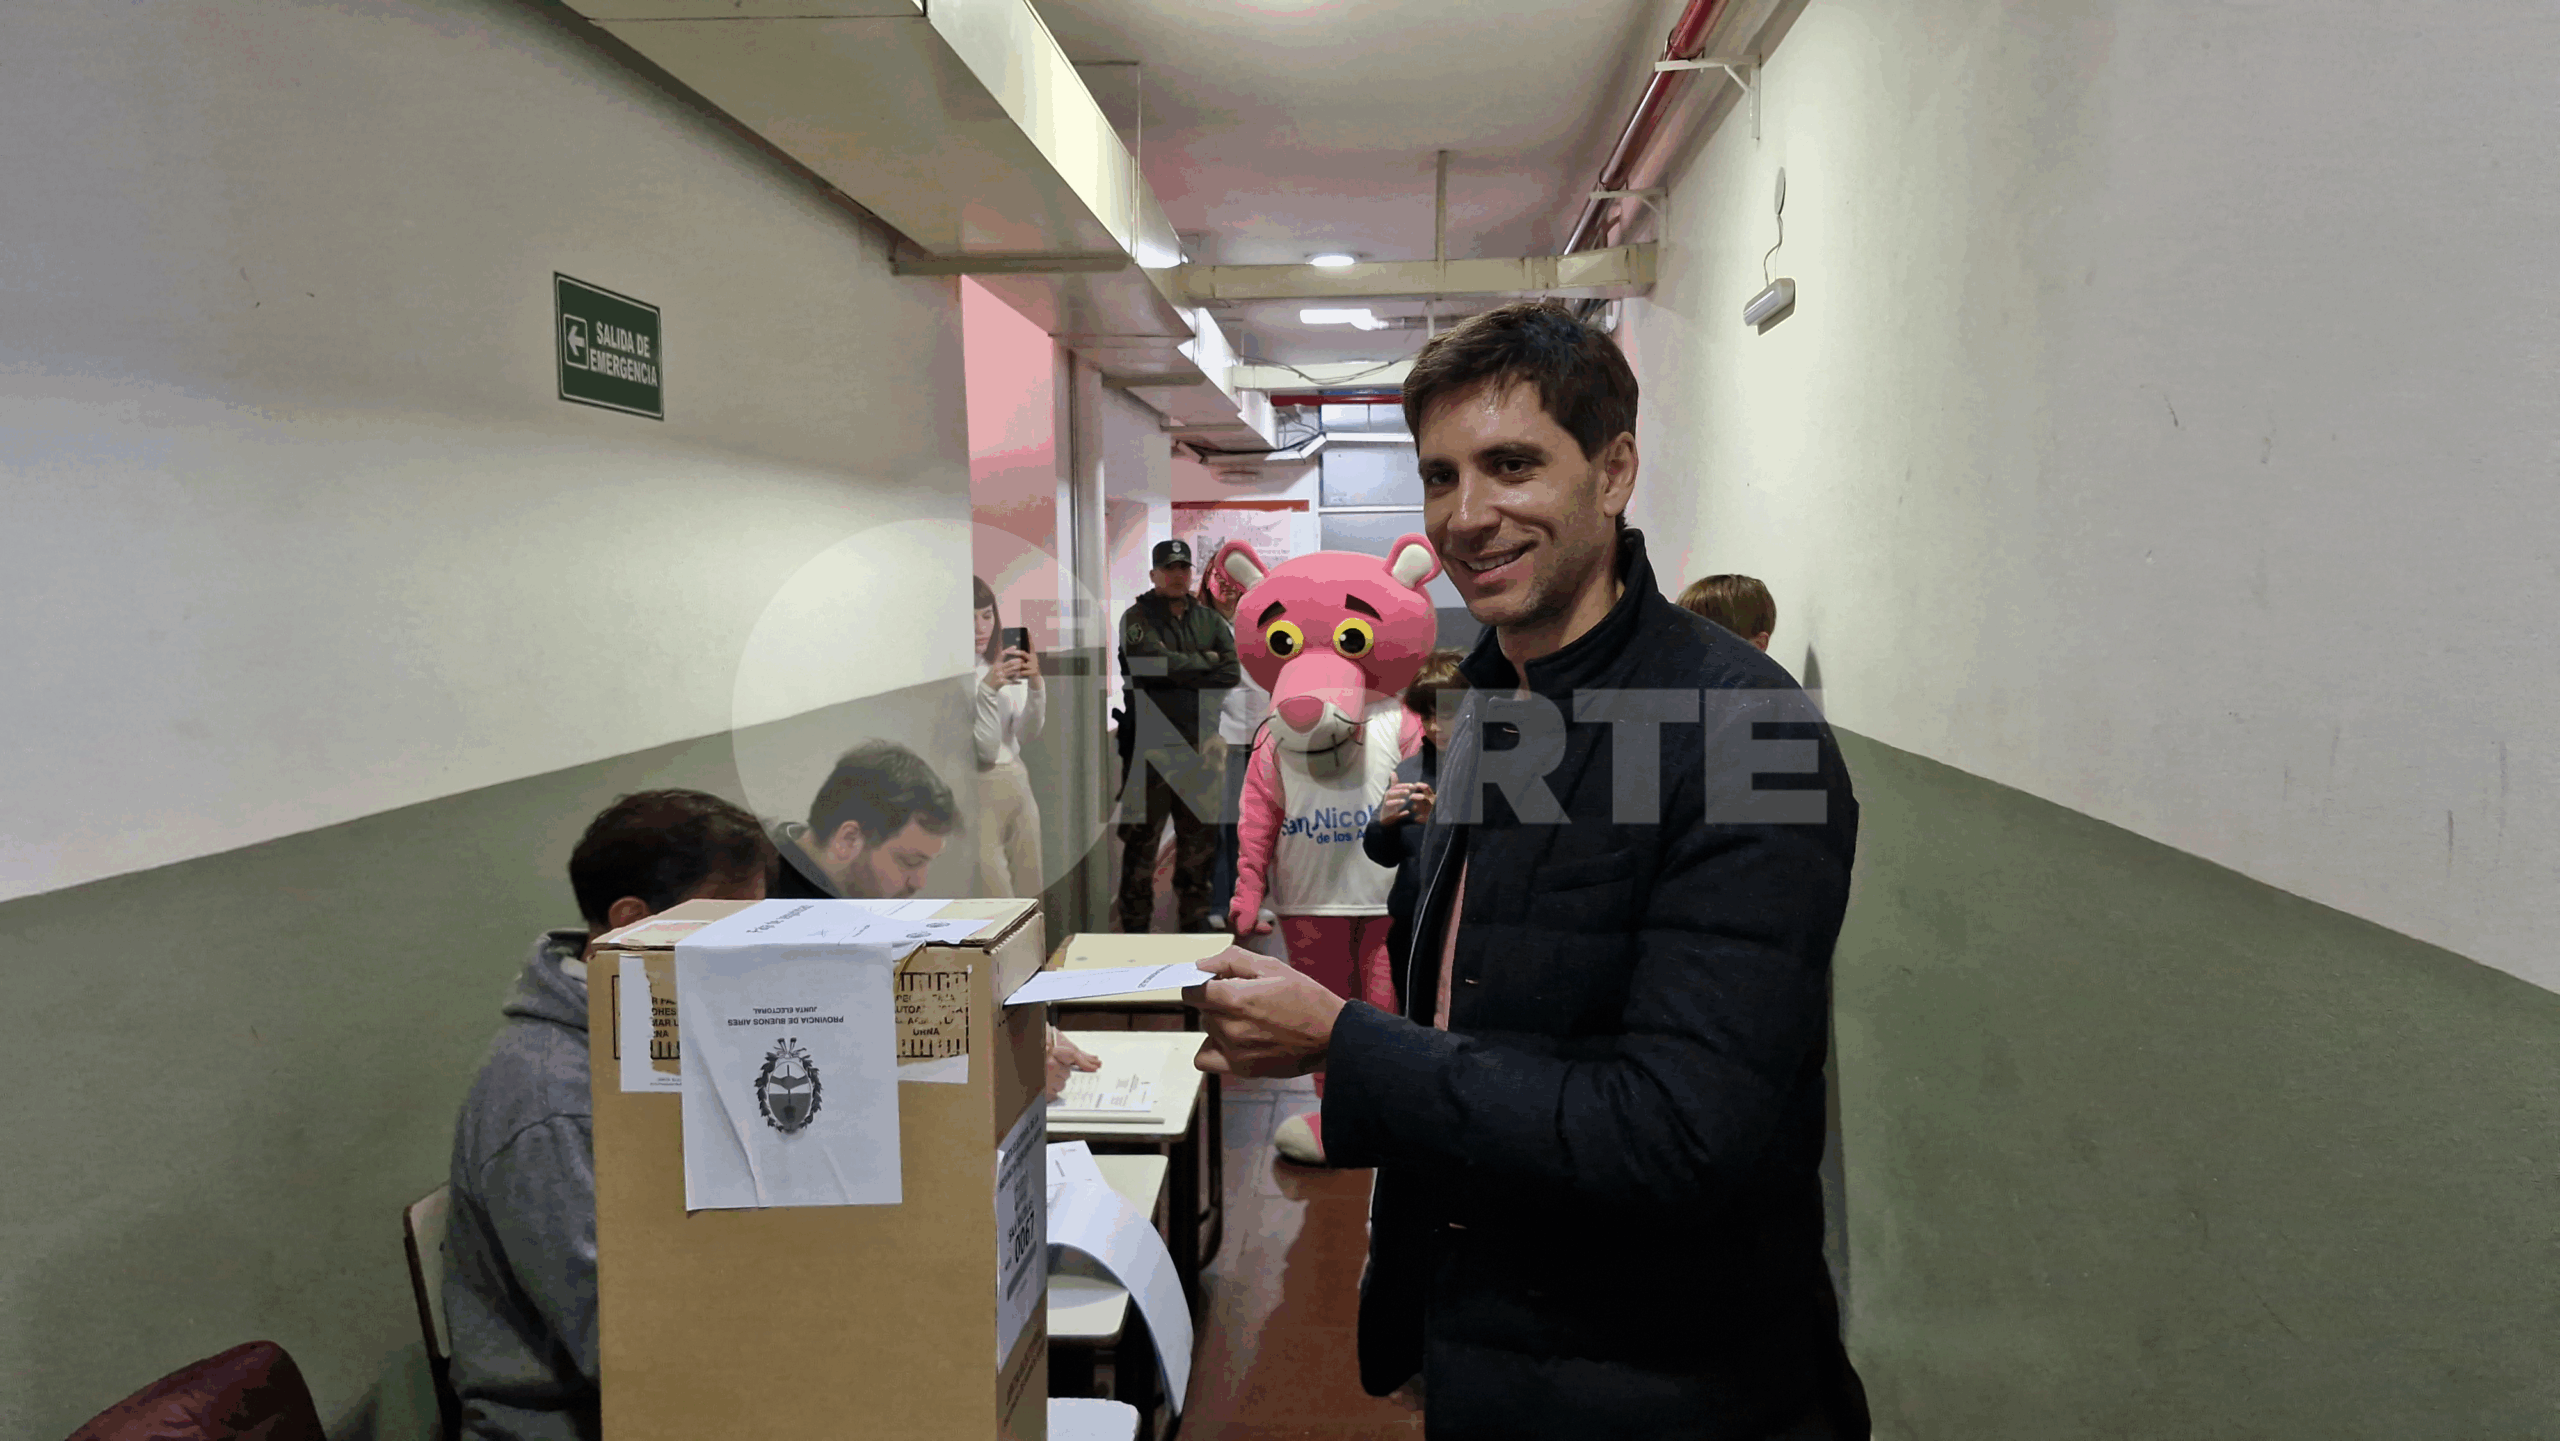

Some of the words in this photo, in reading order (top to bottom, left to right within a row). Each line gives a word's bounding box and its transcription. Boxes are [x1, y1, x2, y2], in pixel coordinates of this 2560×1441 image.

[596, 321, 635, 354] SALIDA
[636, 333, 651, 359] DE
[590, 348, 658, 387] EMERGENCIA
[1281, 816, 1313, 838] San
[1312, 804, 1373, 832] Nicol
[1316, 832, 1330, 844] de
[1333, 831, 1352, 843] los
[753, 1007, 794, 1015] ELECTORAL
[795, 1006, 818, 1014] JUNTA
[727, 1018, 751, 1027] AIRES
[753, 1017, 786, 1026] BUENOS
[788, 1017, 799, 1025] DE
[801, 1015, 844, 1025] PROVINCIA
[1015, 1210, 1034, 1263] 0067
